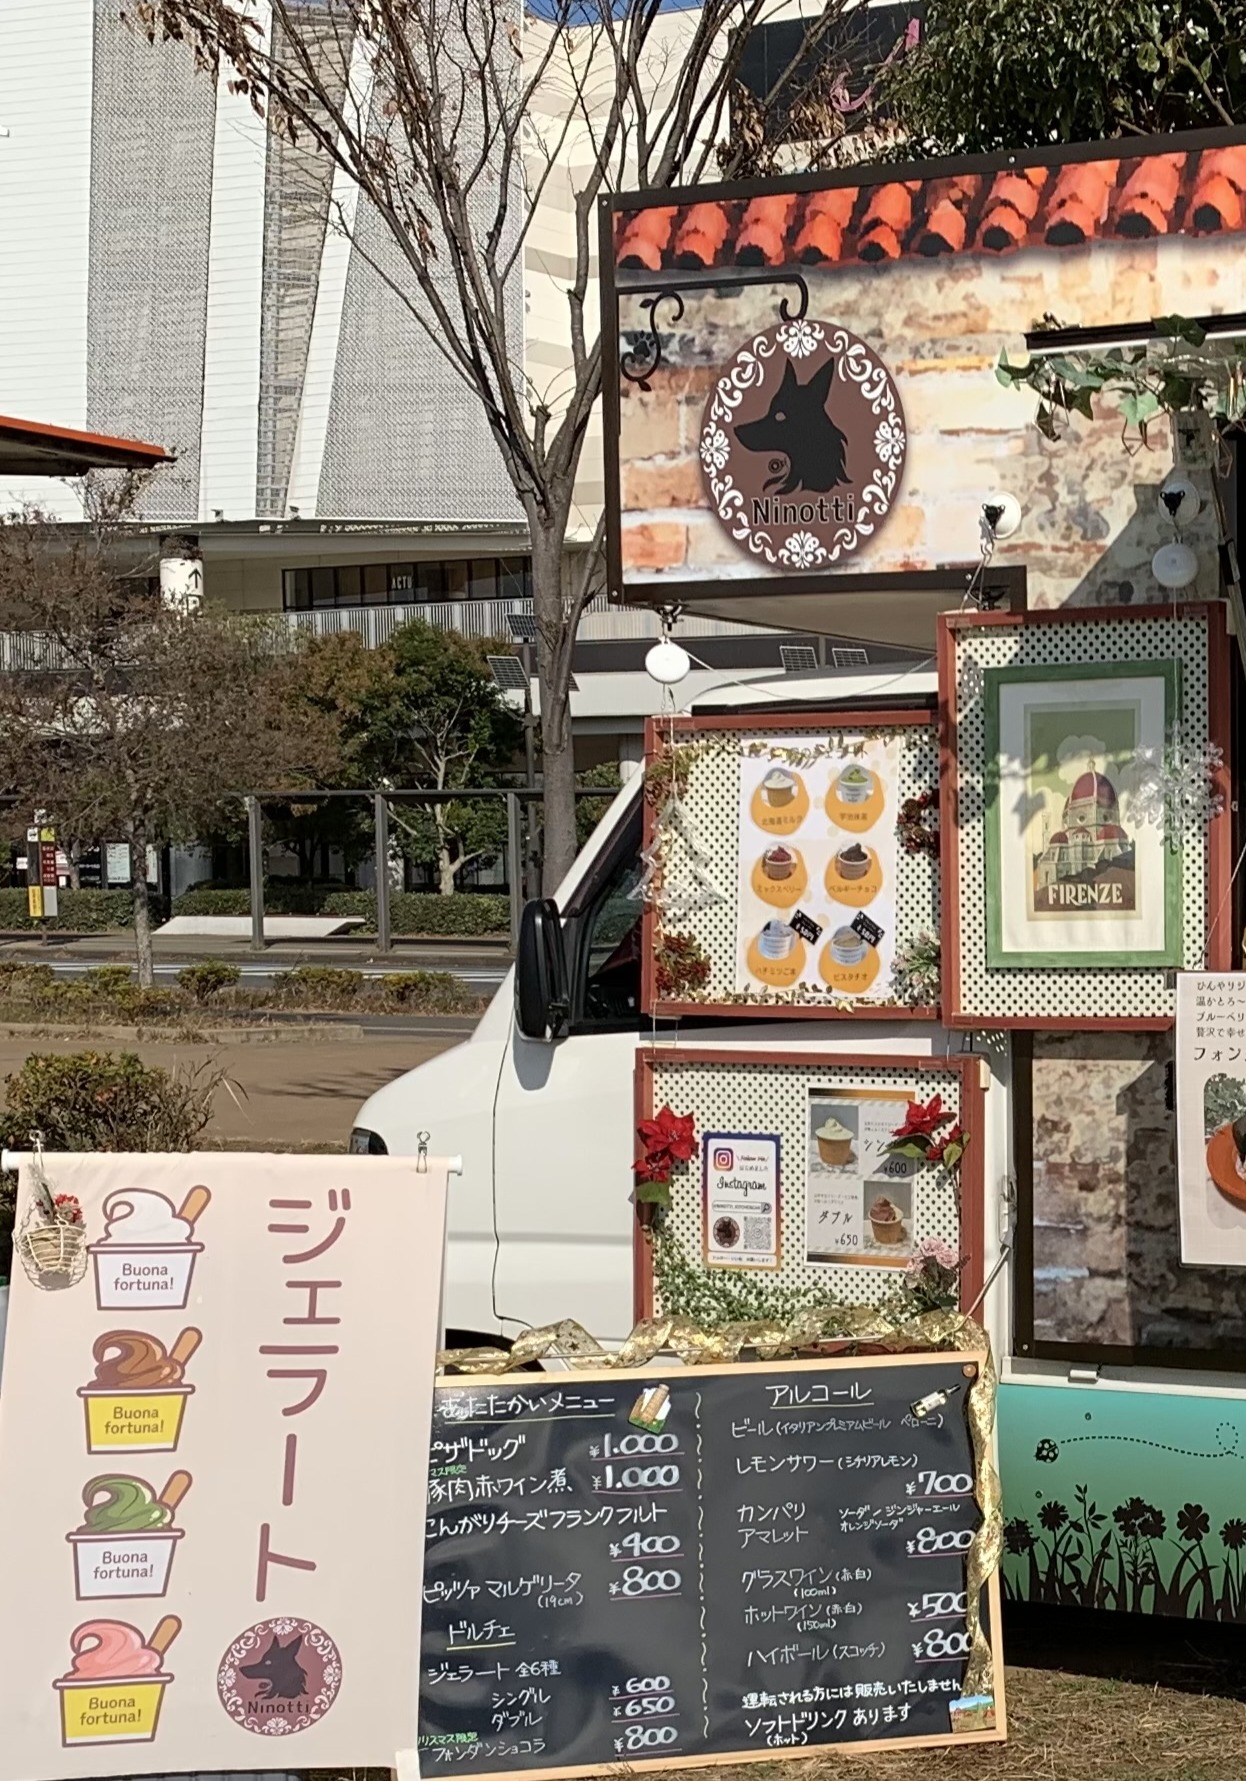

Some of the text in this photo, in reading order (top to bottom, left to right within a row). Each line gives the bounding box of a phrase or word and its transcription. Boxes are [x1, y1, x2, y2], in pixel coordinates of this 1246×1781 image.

[752, 494, 856, 525] Ninotti
[1047, 883, 1123, 907] FIRENZE
[884, 1161, 908, 1174] ¥600
[716, 1176, 768, 1197] Instagram
[818, 1210, 853, 1225] ダブル
[834, 1233, 859, 1246] ¥650
[121, 1262, 169, 1278] Buona
[112, 1275, 175, 1292] fortuna!
[258, 1187, 352, 1603] ジェラート
[766, 1382, 873, 1406] アルコール
[111, 1405, 160, 1420] Buona
[439, 1391, 615, 1419] あたたかいメニュー
[103, 1419, 165, 1435] fortuna!
[905, 1470, 973, 1496] ¥700
[737, 1502, 807, 1523] カンパリ
[840, 1517, 904, 1533] オレンジソーダ
[608, 1531, 681, 1558] ¥400
[737, 1525, 809, 1549] アマレット
[905, 1527, 976, 1554] ¥800
[101, 1549, 150, 1565] Buona
[92, 1563, 154, 1580] fortuna!
[608, 1565, 682, 1596] ¥800
[423, 1571, 582, 1604] ピッツァ マルゲリータ
[793, 1586, 837, 1599] (100ml)
[537, 1591, 584, 1608] (19cm)
[449, 1619, 516, 1645] ドルチェ
[427, 1658, 562, 1685] ジェラート 全6種
[611, 1675, 671, 1697] ¥600
[87, 1694, 136, 1710] Buona
[246, 1698, 312, 1715] Ninotti
[491, 1688, 551, 1708] シングル
[612, 1696, 676, 1717] ¥650
[79, 1708, 142, 1725] fortuna!
[491, 1712, 544, 1732] ダブル
[745, 1702, 912, 1738] ソフトドリンク あります
[614, 1725, 679, 1752] ¥800
[766, 1732, 808, 1747] (ホット)
